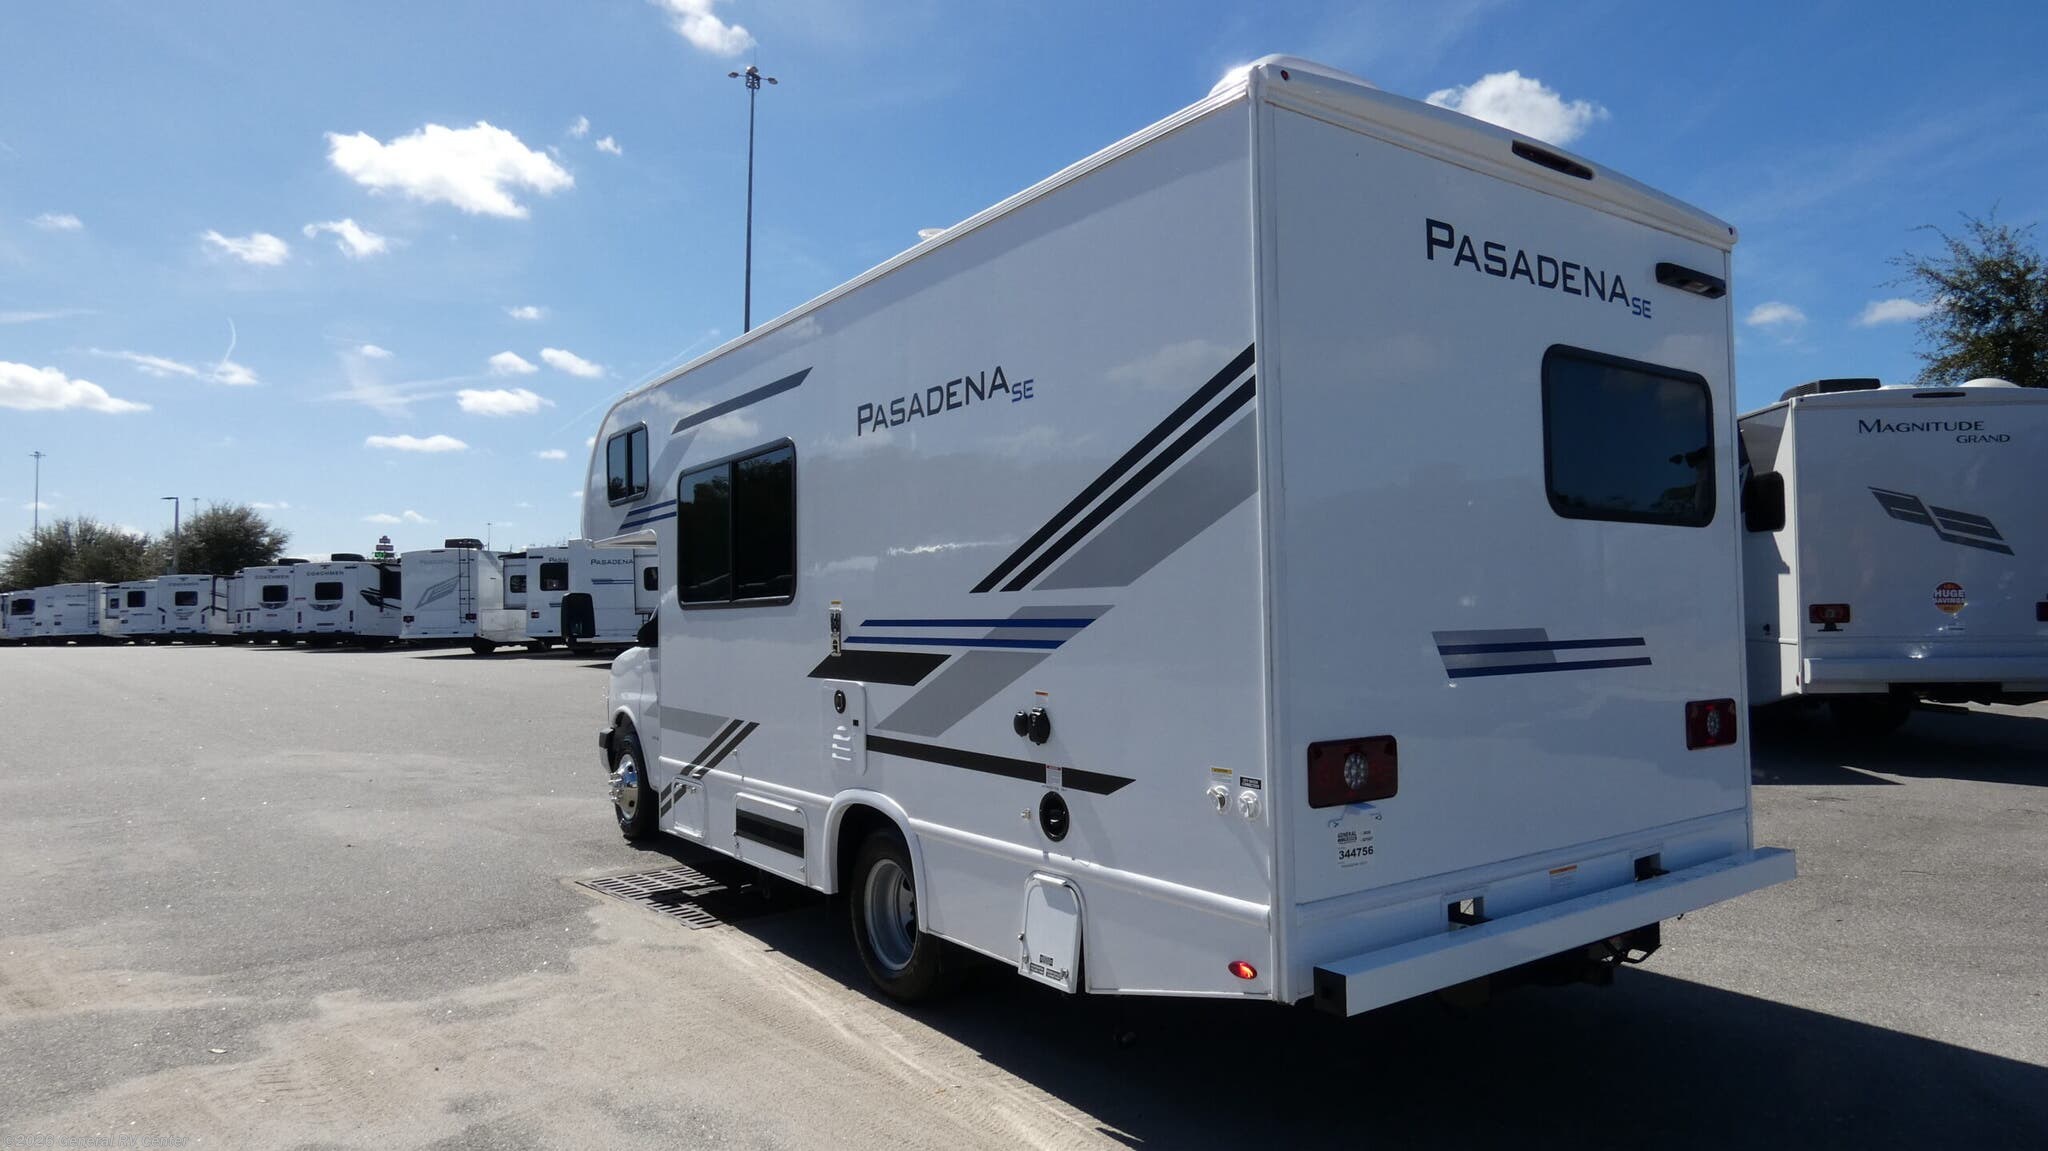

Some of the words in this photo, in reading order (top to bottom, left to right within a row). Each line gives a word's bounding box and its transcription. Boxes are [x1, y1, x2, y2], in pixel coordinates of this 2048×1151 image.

[1425, 218, 1630, 307] PASADENA
[1631, 297, 1652, 319] SE
[857, 366, 1010, 436] PASADENA
[1011, 379, 1034, 403] SE
[1858, 418, 1985, 434] MAGNITUDE
[1955, 433, 2011, 444] GRAND
[1934, 589, 1965, 598] HUGE
[1338, 845, 1374, 860] 344756
